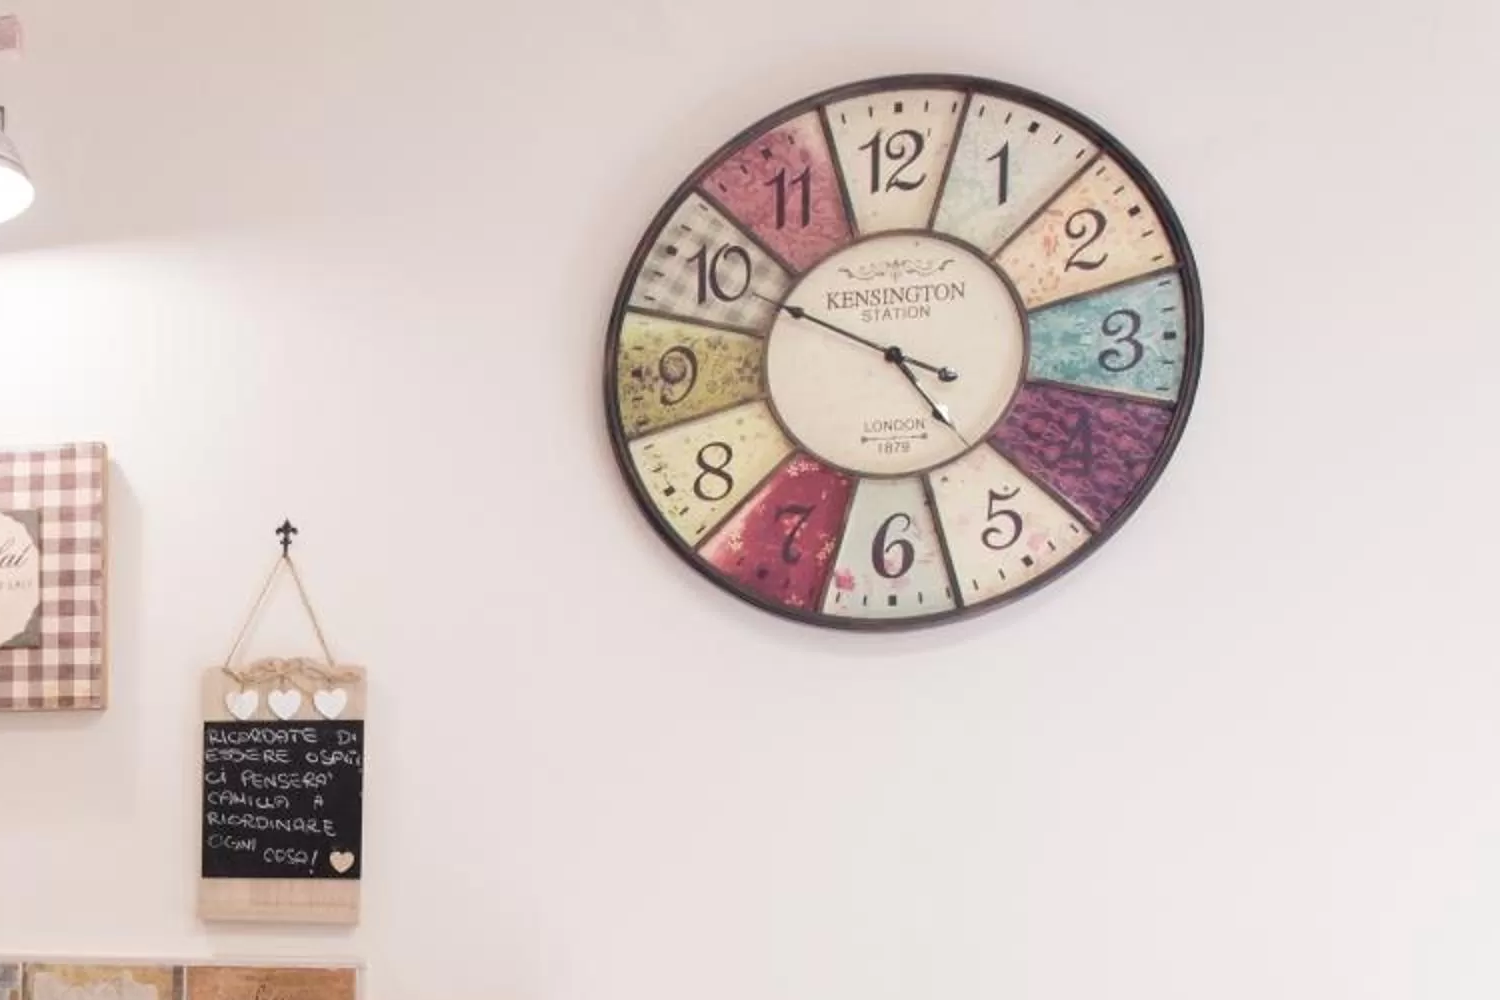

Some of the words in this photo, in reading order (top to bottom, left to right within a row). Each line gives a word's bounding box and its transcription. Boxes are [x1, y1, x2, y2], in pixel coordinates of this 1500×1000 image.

[859, 128, 928, 195] 12
[987, 140, 1011, 206] 1
[768, 165, 813, 231] 11
[1063, 206, 1110, 273] 2
[688, 244, 754, 305] 10
[825, 281, 966, 311] KENSINGTON
[861, 304, 931, 323] STATION
[1097, 308, 1145, 374] 3
[658, 345, 699, 406] 9
[862, 418, 926, 433] LONDON
[876, 440, 911, 455] 1879
[692, 440, 734, 501] 8
[773, 503, 816, 565] 7
[870, 512, 915, 579] 6
[980, 487, 1024, 551] 5
[205, 748, 293, 764] ESSERE
[207, 727, 318, 745] RICORDATE
